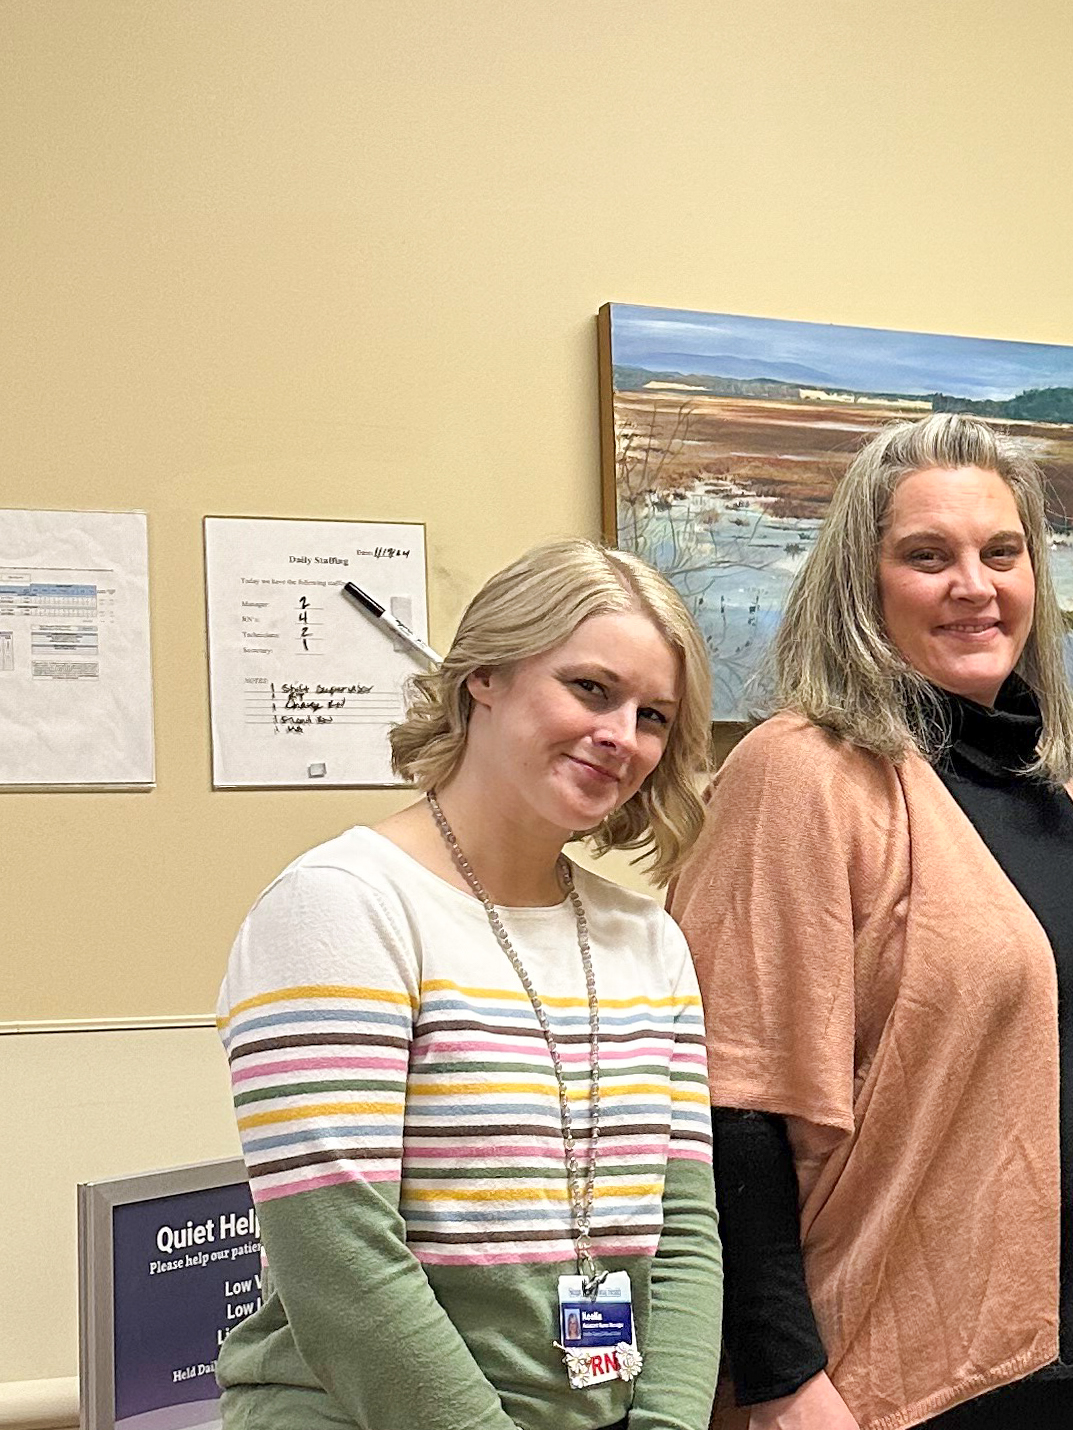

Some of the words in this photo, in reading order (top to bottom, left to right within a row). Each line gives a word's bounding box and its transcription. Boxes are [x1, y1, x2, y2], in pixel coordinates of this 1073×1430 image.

[289, 555, 312, 565] Daily
[314, 556, 349, 566] Staffing
[299, 596, 310, 609] 2
[299, 610, 308, 624] 4
[301, 626, 313, 637] 2
[156, 1219, 215, 1254] Quiet
[149, 1258, 184, 1275] Please
[185, 1252, 210, 1267] help
[210, 1249, 230, 1260] our
[224, 1279, 253, 1297] Low
[227, 1302, 255, 1320] Low
[591, 1350, 620, 1377] RN
[172, 1366, 197, 1383] Held
